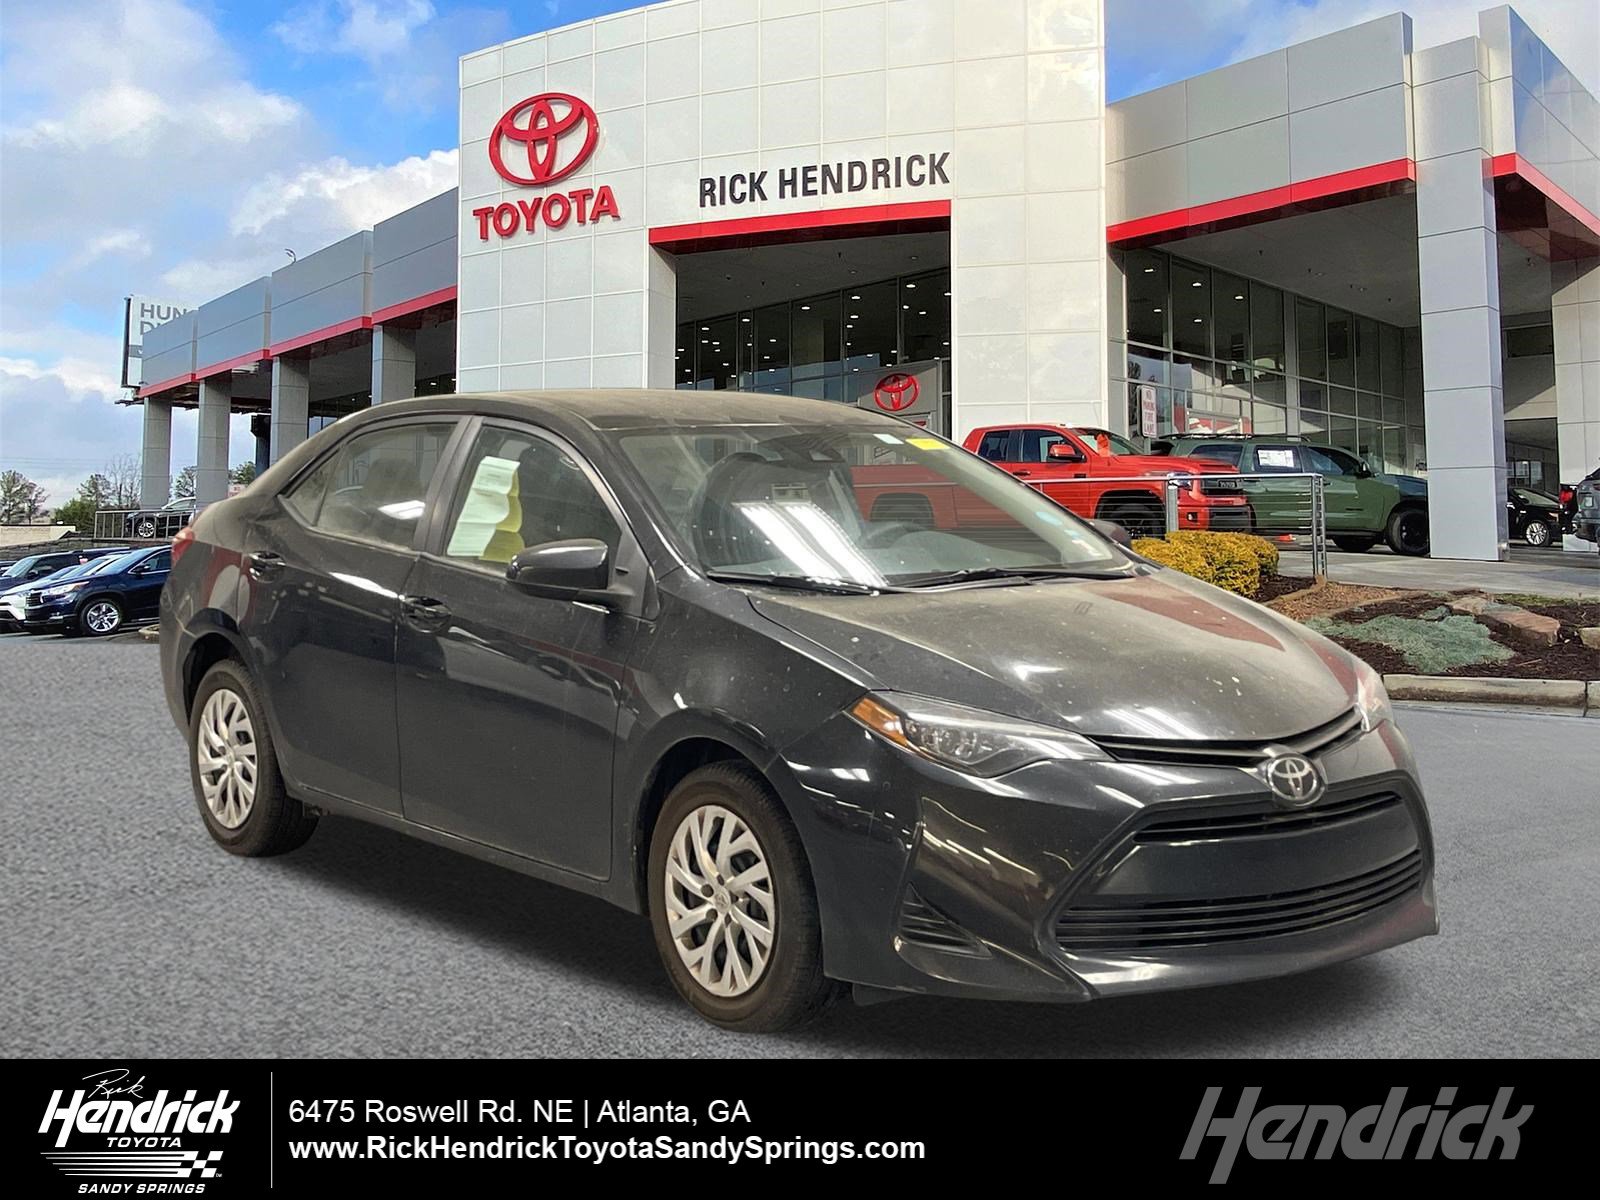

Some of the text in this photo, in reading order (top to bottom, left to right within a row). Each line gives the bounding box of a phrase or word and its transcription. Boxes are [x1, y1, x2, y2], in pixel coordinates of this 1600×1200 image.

[699, 152, 952, 208] RICK HENDRICK
[473, 185, 621, 240] TOYOTA
